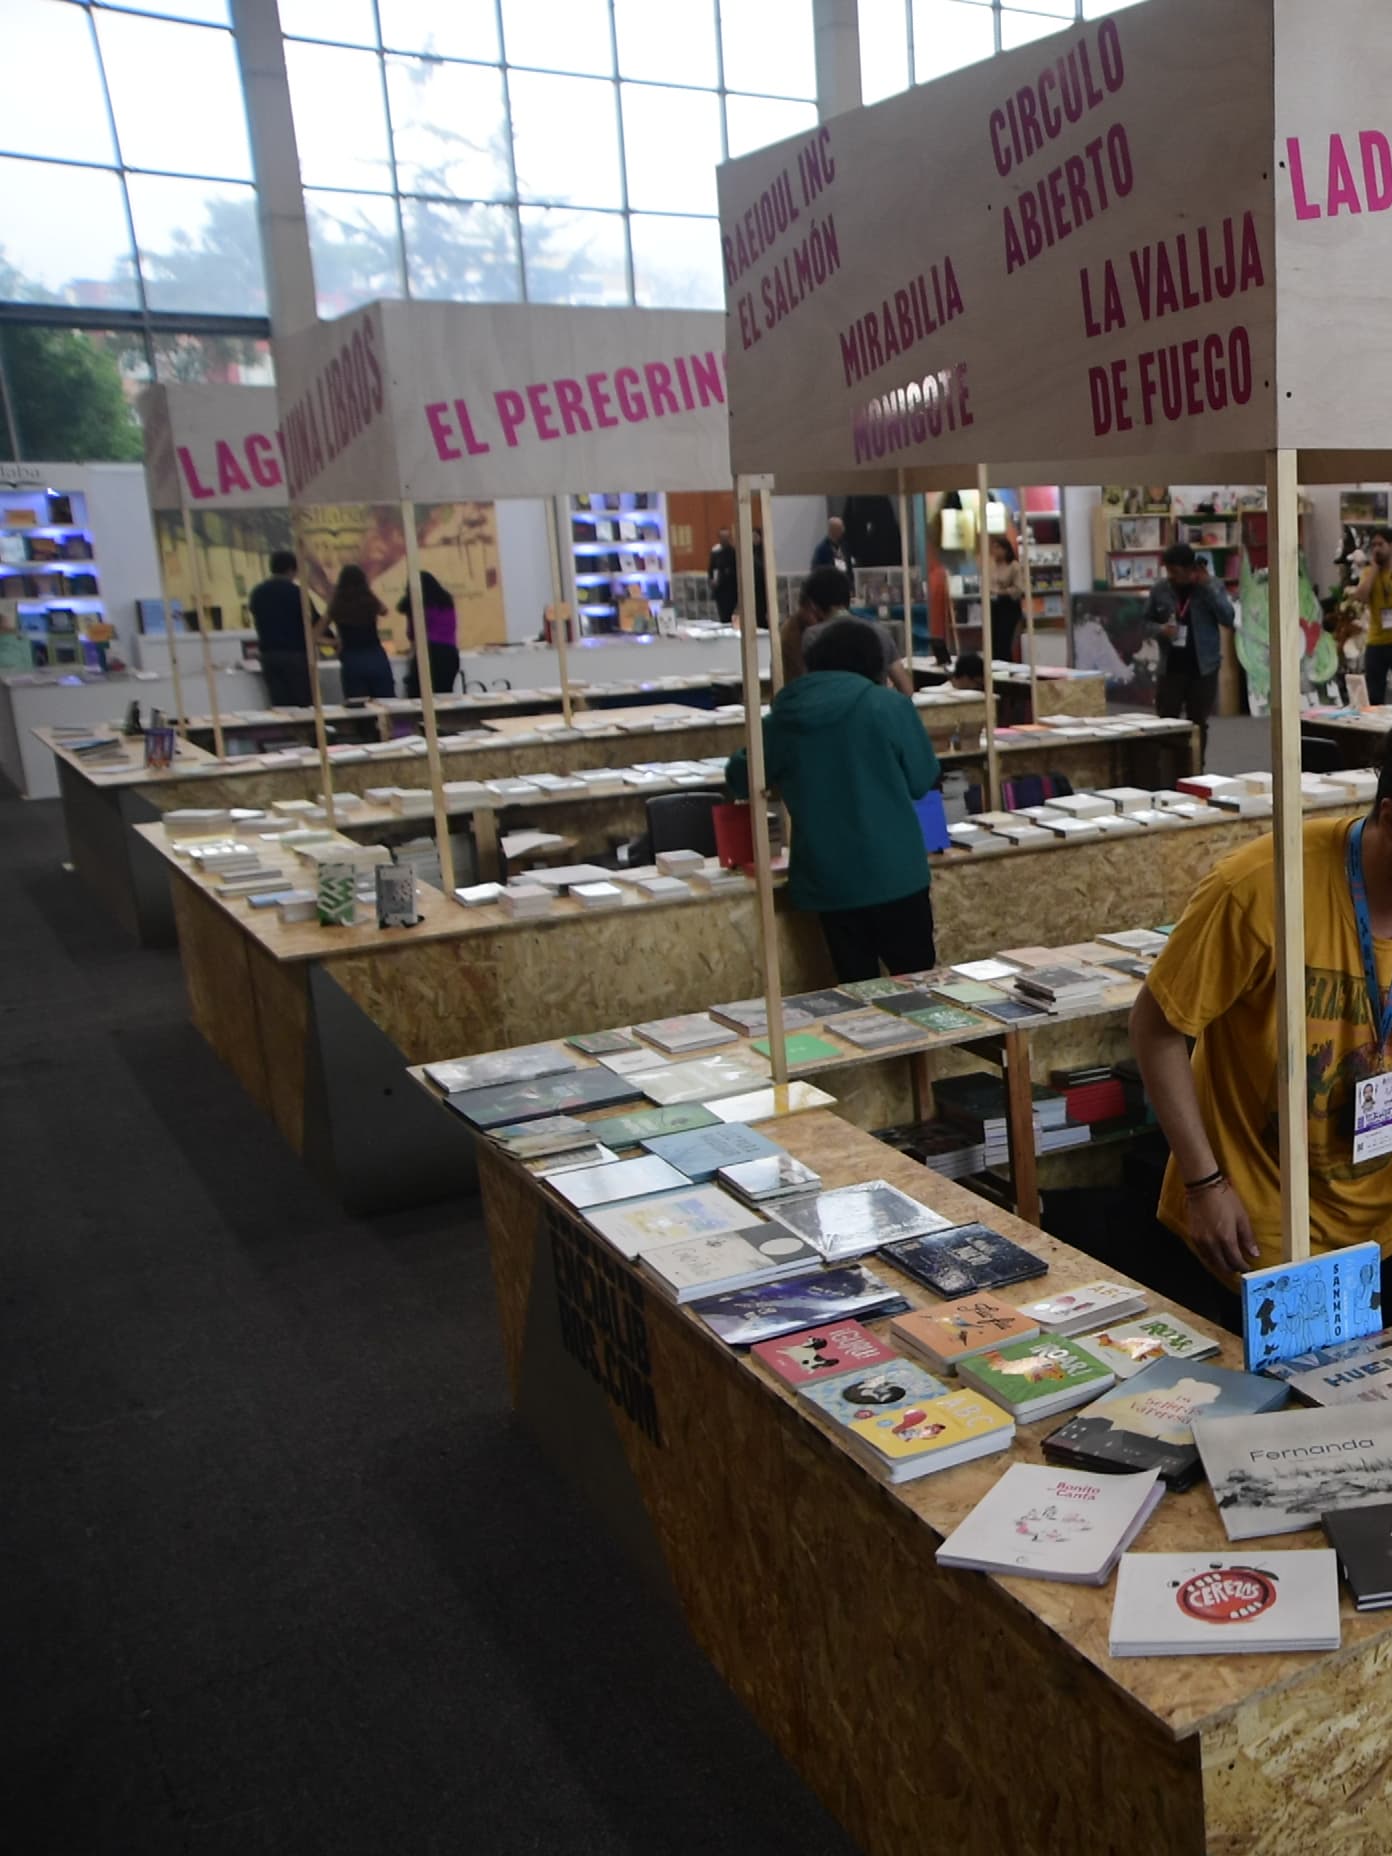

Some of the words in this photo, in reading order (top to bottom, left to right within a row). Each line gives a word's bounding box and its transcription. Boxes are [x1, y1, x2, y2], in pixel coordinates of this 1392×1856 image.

[989, 18, 1125, 177] CIRCULO
[797, 125, 836, 207] INC
[1001, 123, 1133, 275] ABIERTO
[738, 291, 762, 350] EL
[761, 212, 841, 330] SALMÓN
[839, 255, 965, 388] MIRABILIA
[1080, 259, 1127, 338] LA
[1130, 211, 1265, 322] VALIJA
[317, 314, 384, 462] LIBROS
[425, 398, 489, 461] EL
[494, 351, 727, 447] PEREGRIN
[852, 361, 975, 465] MONIGOTE
[1089, 359, 1133, 436] DE
[1138, 326, 1253, 426] FUEGO
[177, 428, 287, 499] LAG
[1332, 1263, 1342, 1337] SANMAO
[1056, 1481, 1101, 1493] Bonito
[1056, 1489, 1096, 1501] Canta
[1249, 1437, 1376, 1464] Fernanda
[1189, 1579, 1260, 1608] CEREZAS
